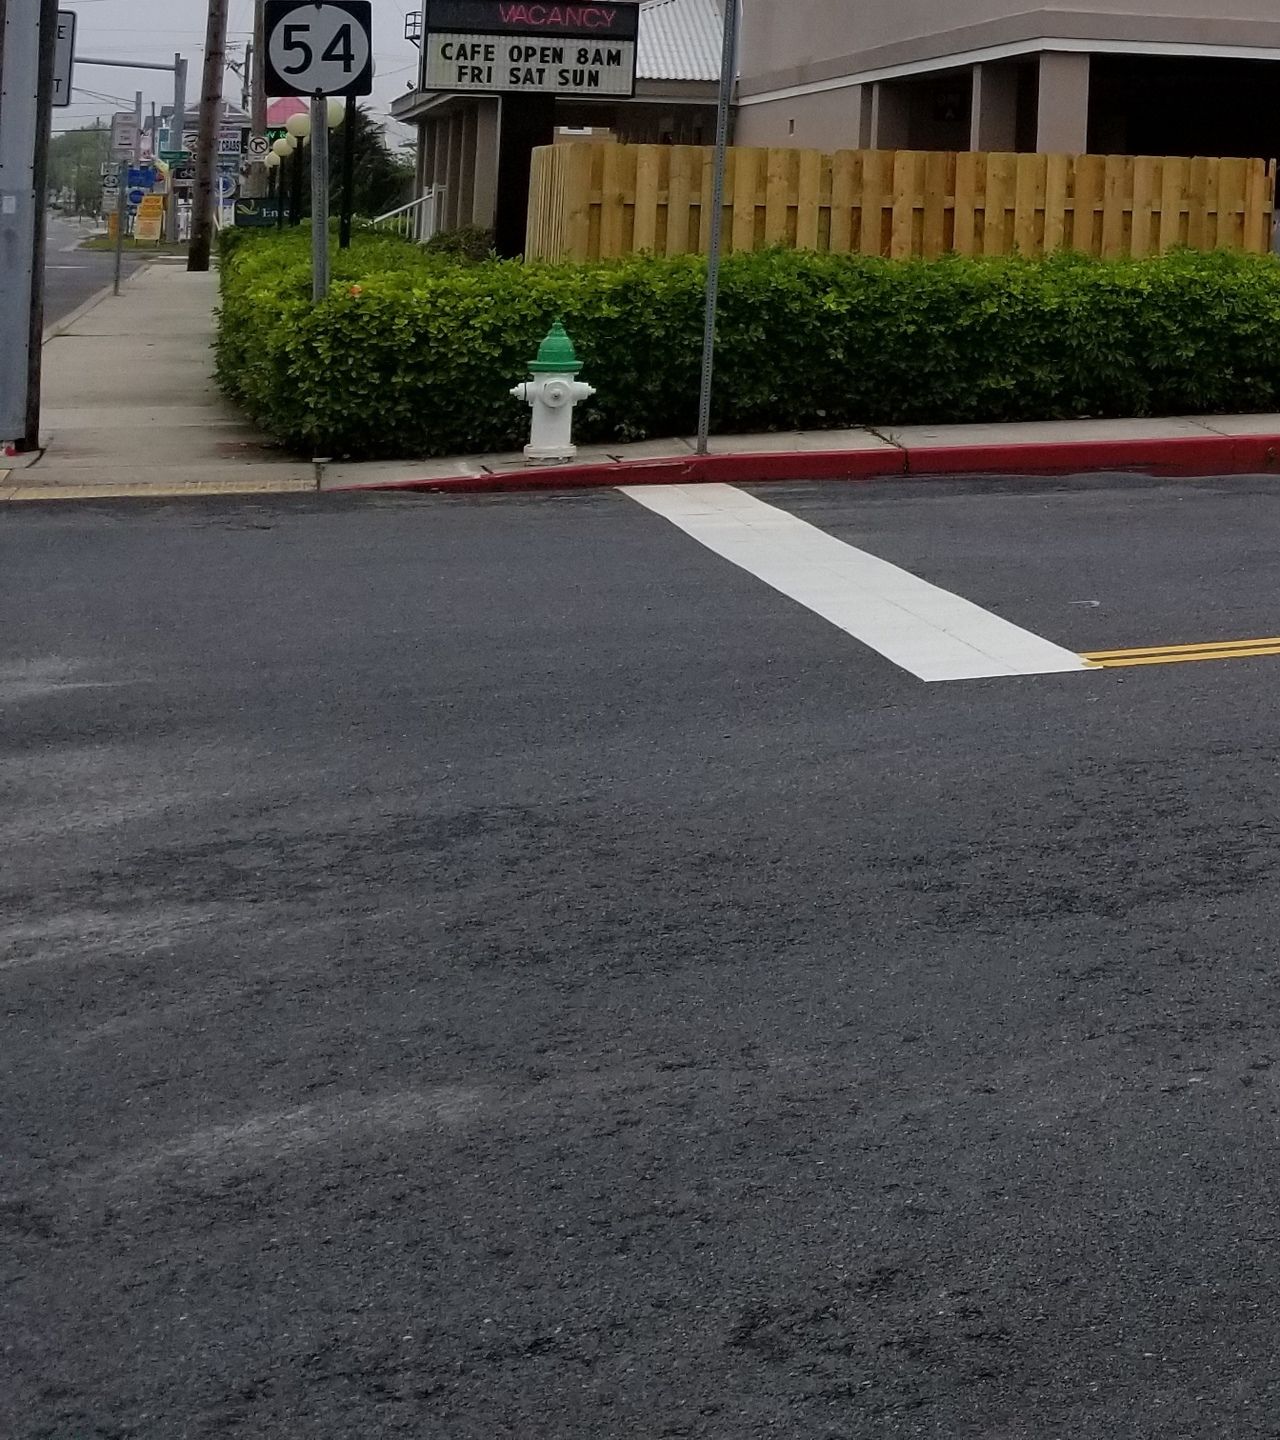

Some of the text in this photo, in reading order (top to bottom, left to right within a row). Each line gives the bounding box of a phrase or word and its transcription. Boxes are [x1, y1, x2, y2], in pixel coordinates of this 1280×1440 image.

[499, 3, 617, 28] VACANCY
[283, 23, 355, 75] 54
[440, 42, 622, 67] CAFE OPEN 8AM
[457, 65, 600, 87] FRI SAT SUN
